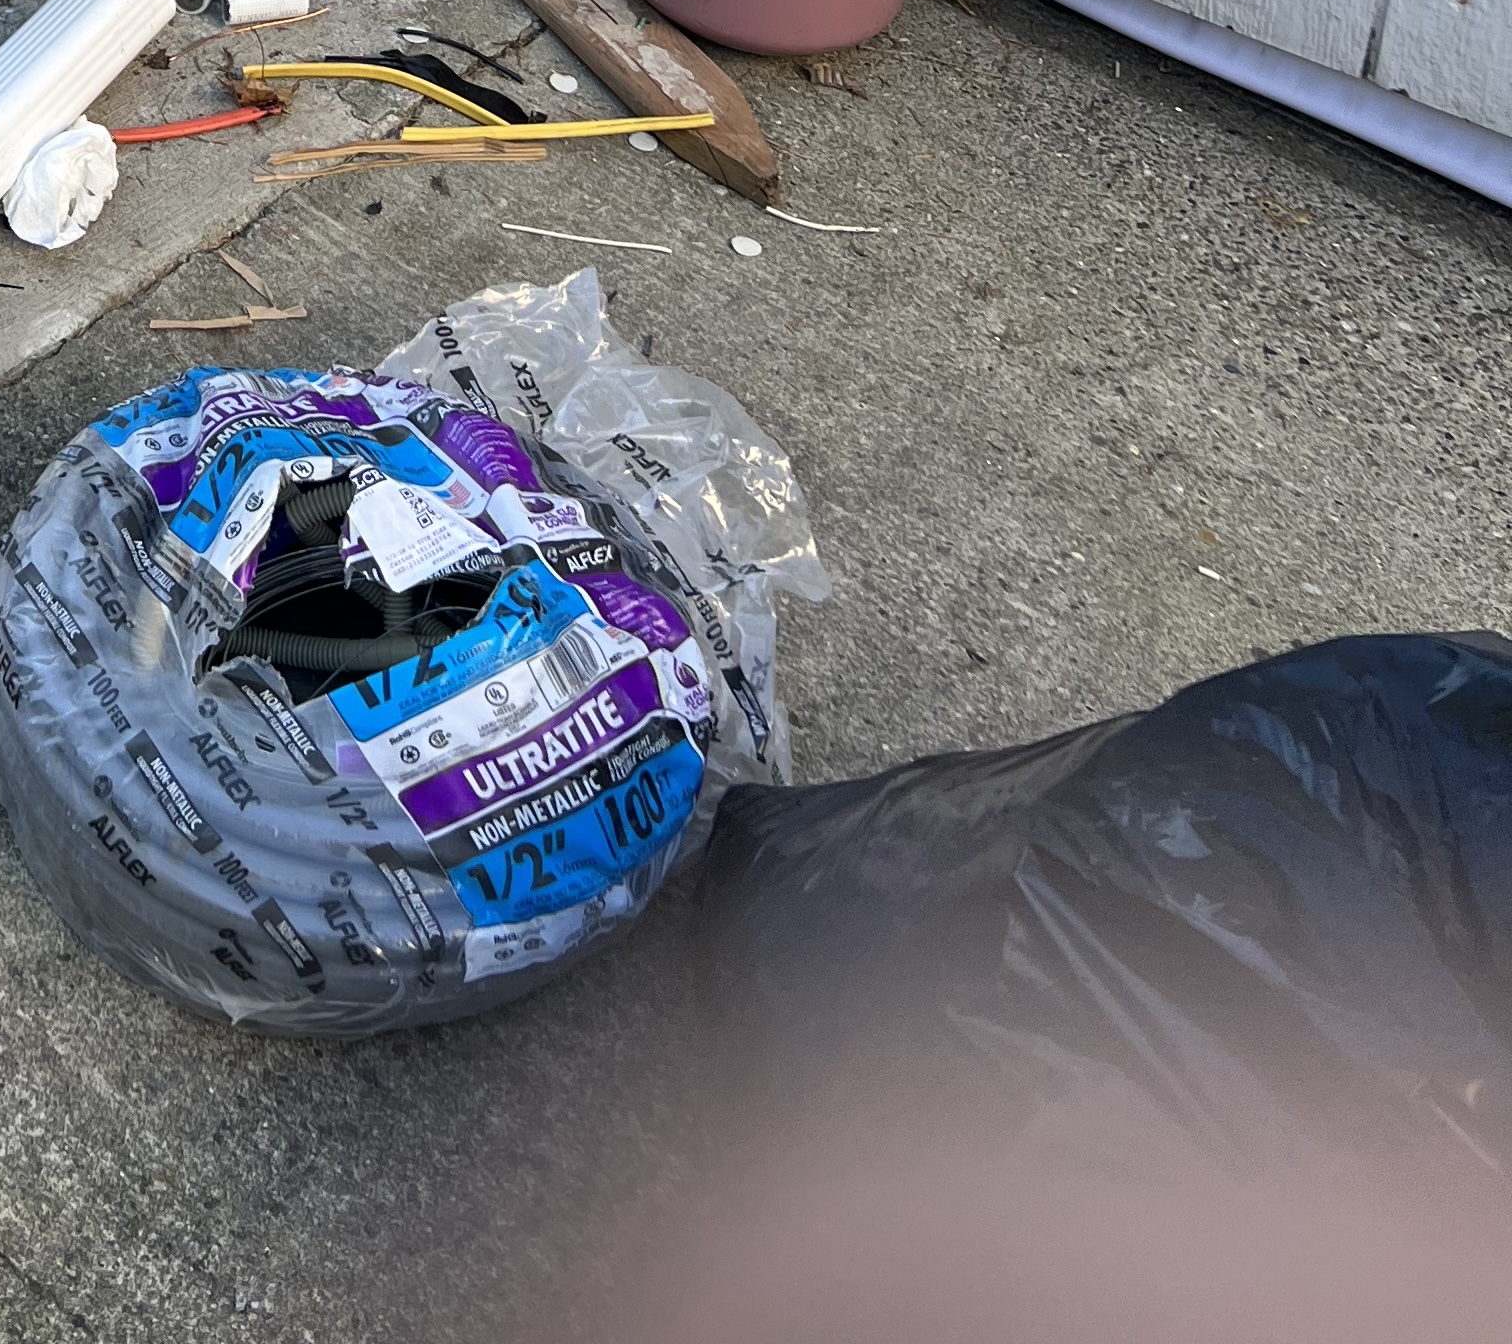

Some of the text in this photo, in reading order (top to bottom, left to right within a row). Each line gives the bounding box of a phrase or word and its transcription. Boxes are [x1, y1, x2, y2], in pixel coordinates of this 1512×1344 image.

[183, 430, 264, 525] 1/2"
[69, 556, 131, 632] ALFLEX
[566, 544, 615, 573] ALFLEX
[88, 668, 132, 734] 100 FEET
[259, 689, 316, 757] NON-METALLIC
[189, 731, 262, 812] ALFLEX
[462, 689, 625, 801] ULTRATITE
[150, 757, 203, 830] NON-METALLIC
[469, 768, 603, 851] NON-METALLIC
[603, 769, 666, 849] 100
[88, 814, 157, 888] ALFLEX
[213, 850, 249, 887] 100
[468, 828, 566, 901] 1/2"
